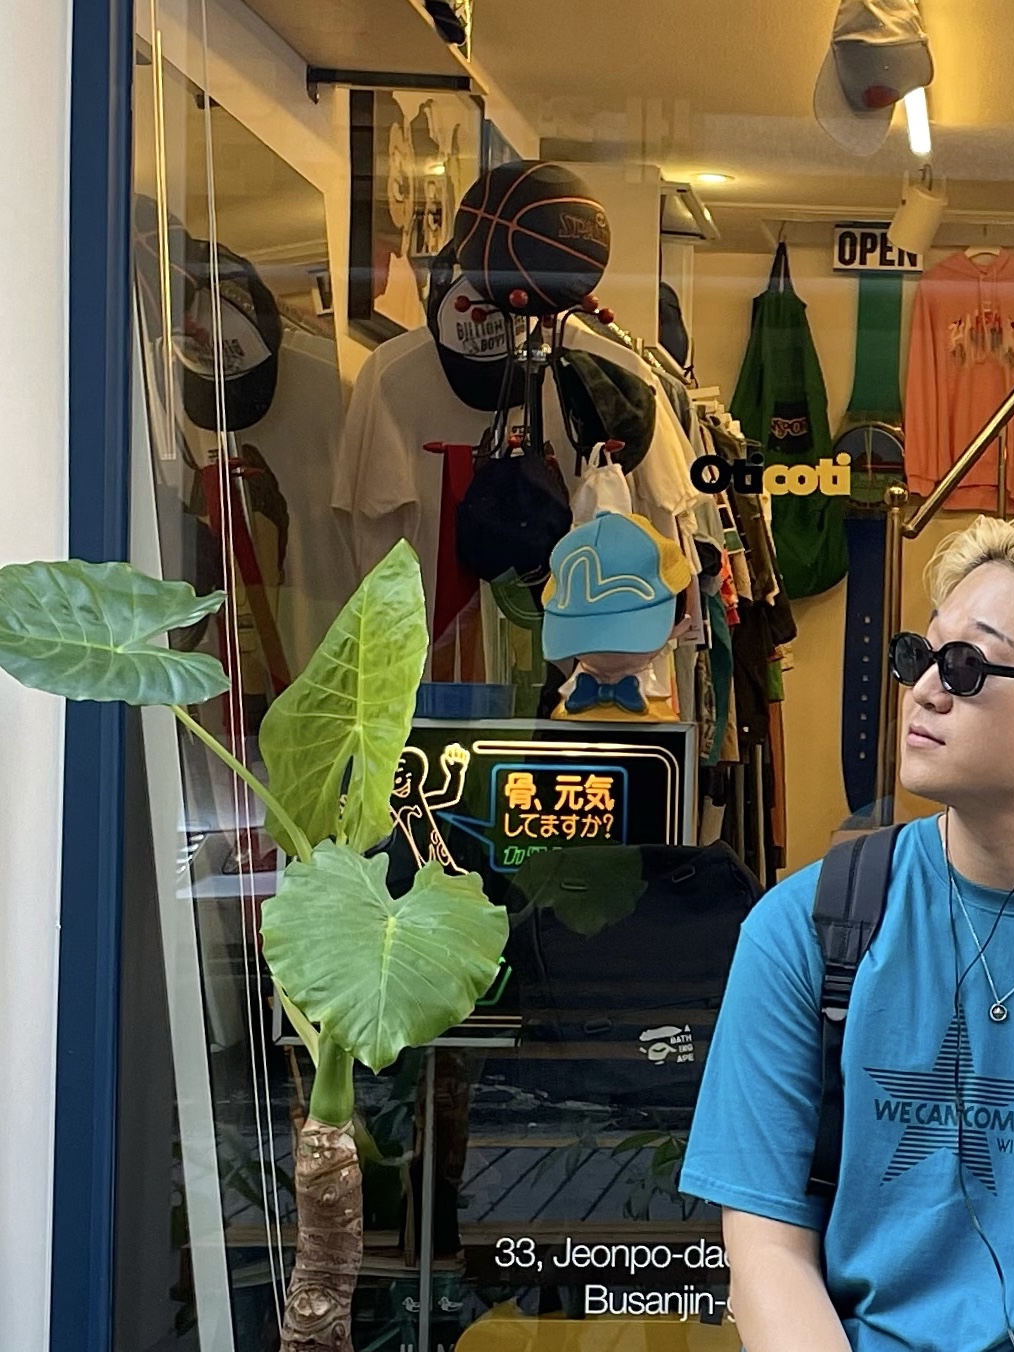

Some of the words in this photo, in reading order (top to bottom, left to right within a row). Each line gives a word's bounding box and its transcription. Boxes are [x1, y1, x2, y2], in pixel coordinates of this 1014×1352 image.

[838, 231, 918, 267] OPEN
[690, 452, 851, 496] Oticoti
[504, 772, 615, 811] 骨、元気
[670, 1034, 692, 1044] BATH
[874, 1098, 912, 1123] WE
[915, 1102, 959, 1126] CAN
[494, 1237, 544, 1273] 33,
